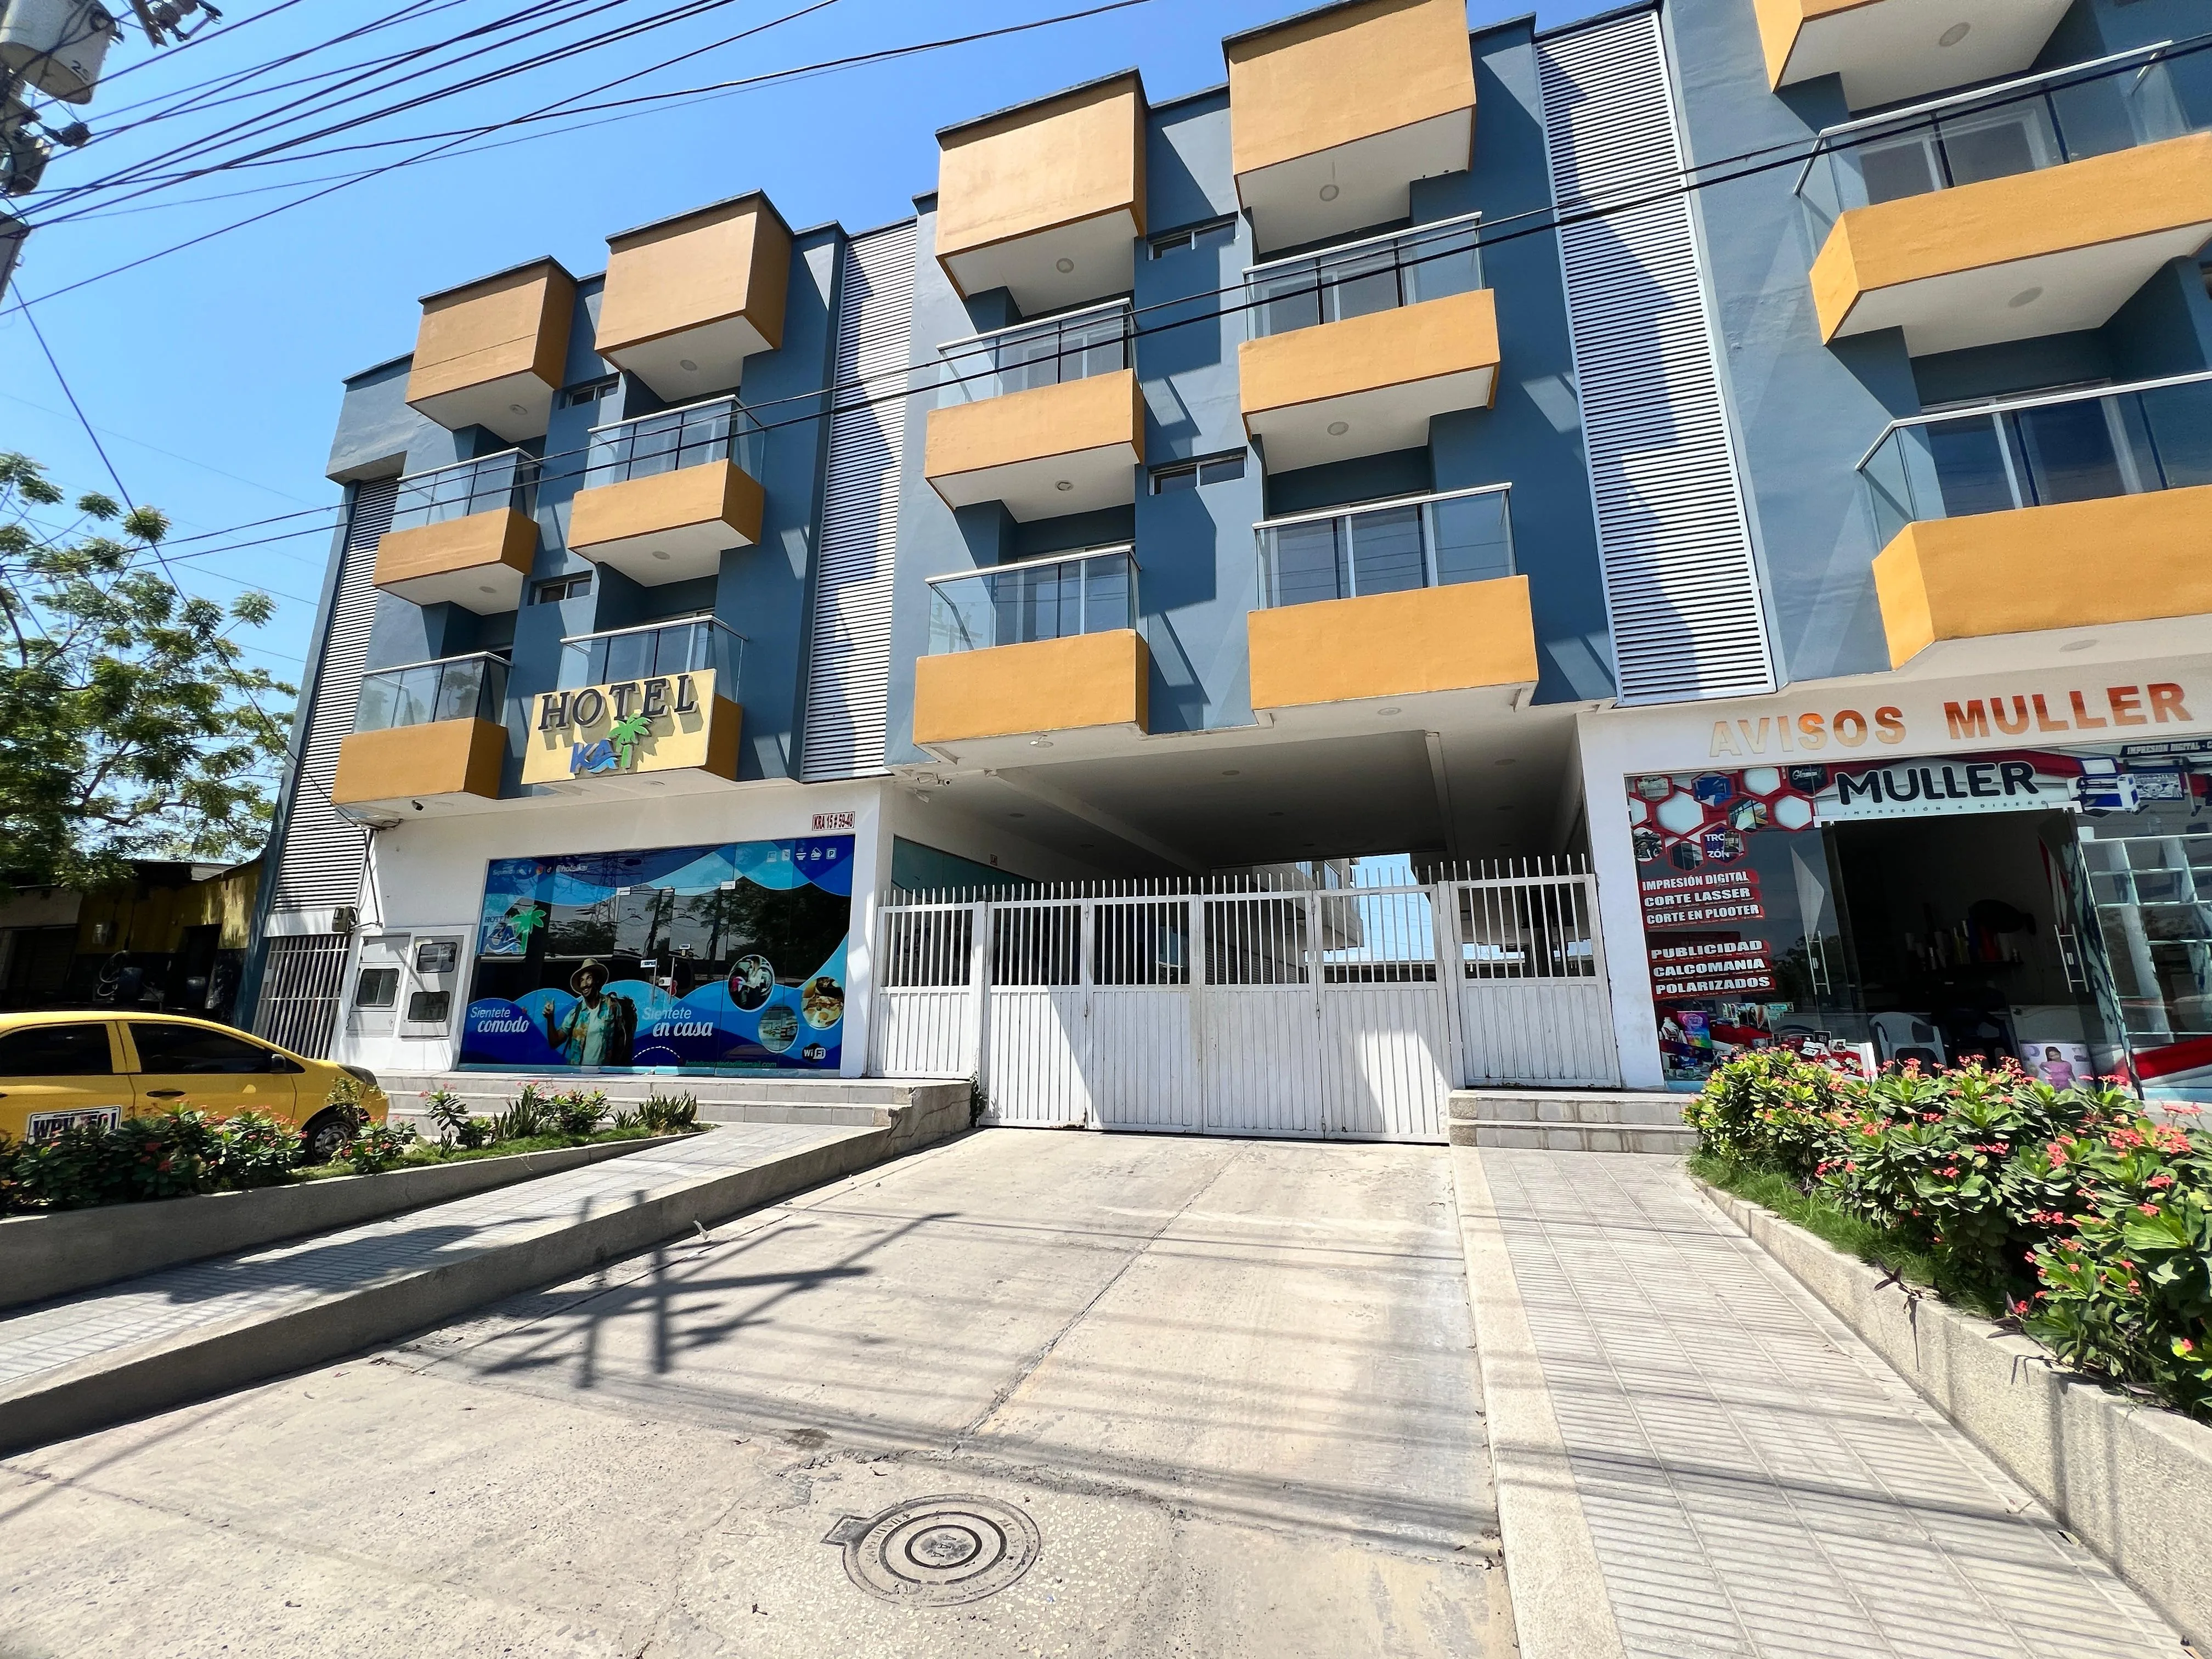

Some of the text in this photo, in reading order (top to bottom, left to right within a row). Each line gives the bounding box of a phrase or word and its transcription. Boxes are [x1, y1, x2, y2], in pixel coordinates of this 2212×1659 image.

[538, 674, 698, 731] HOTEL
[1709, 682, 2194, 758] AVISOS MULLER
[1836, 761, 2040, 805] MULLER
[814, 815, 825, 830] KRA
[827, 815, 833, 829] 15
[1642, 871, 1750, 891] IMPRESIÓN DIGITAL
[1644, 893, 1692, 907] CORTE
[1694, 888, 1751, 902] LASSER
[1646, 912, 1686, 925] CORTE
[1688, 910, 1703, 921] EN
[1705, 904, 1760, 919] PLOOTER
[1651, 940, 1763, 960] PUBLICIDAD
[1653, 958, 1765, 977] CALCOMANIA
[1655, 977, 1770, 995] POLARIZADOS
[477, 1015, 531, 1032] comodo
[653, 1021, 713, 1037] en casa
